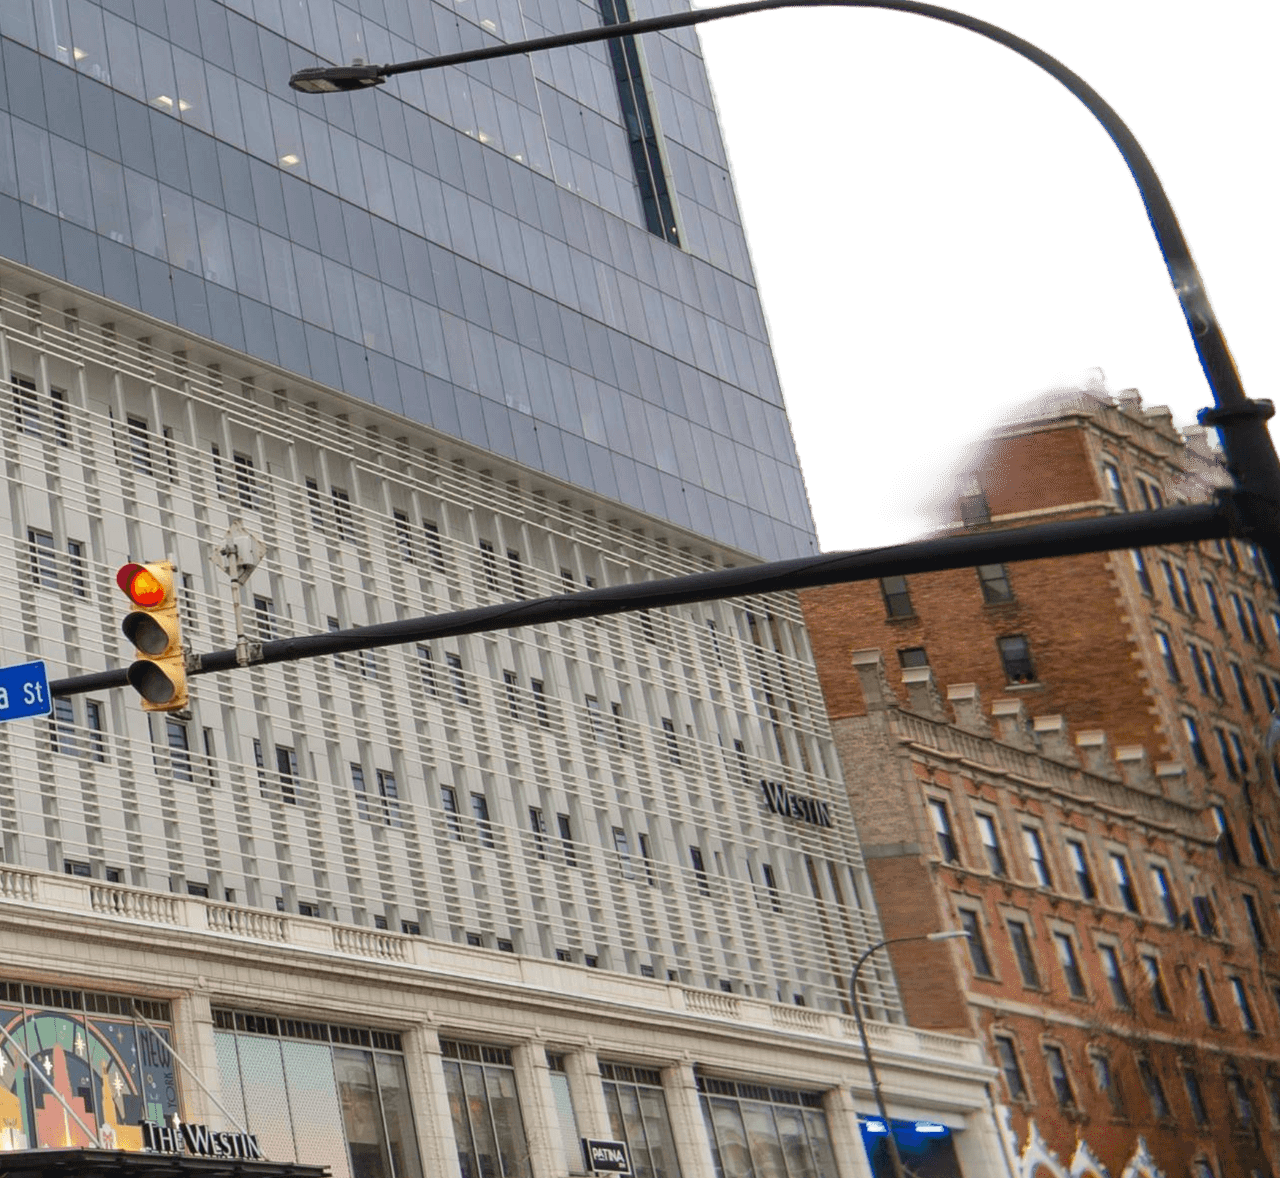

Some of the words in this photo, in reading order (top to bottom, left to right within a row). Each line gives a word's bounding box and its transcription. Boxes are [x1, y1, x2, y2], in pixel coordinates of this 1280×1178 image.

[23, 680, 44, 706] St
[140, 1030, 171, 1068] NEW
[592, 1147, 626, 1162] PATINA
